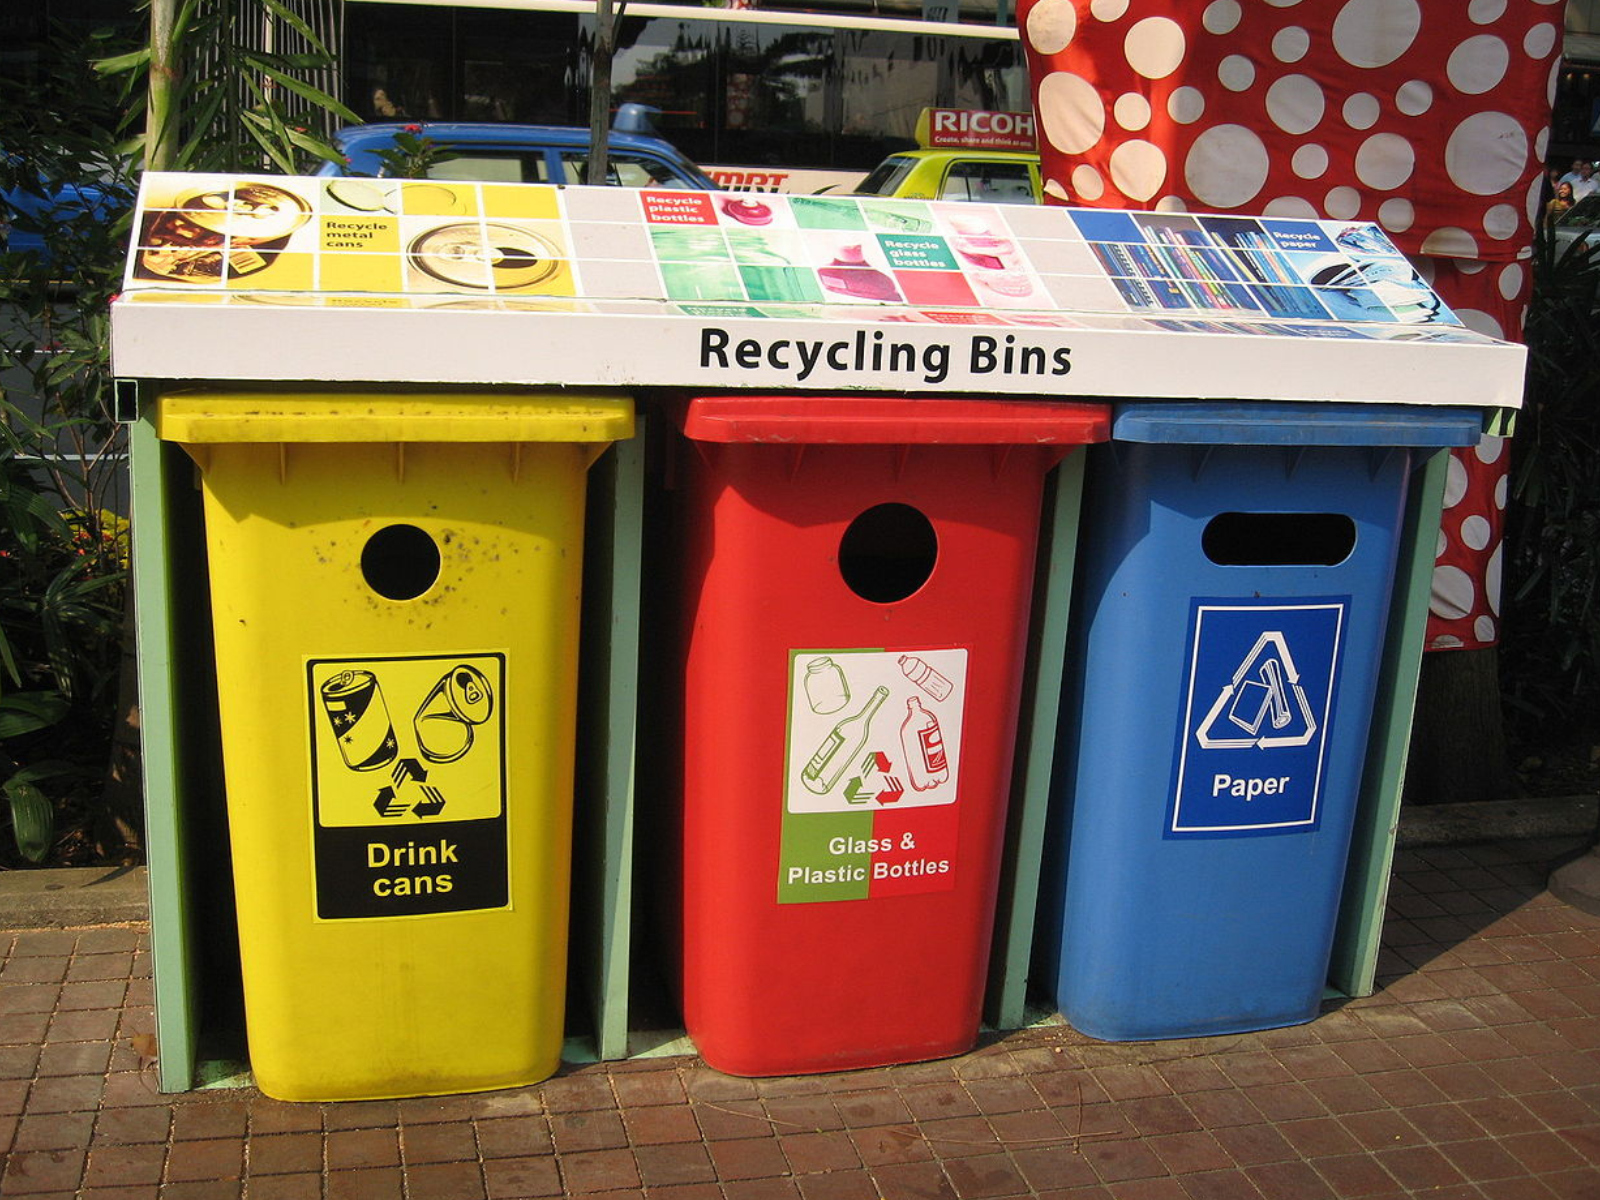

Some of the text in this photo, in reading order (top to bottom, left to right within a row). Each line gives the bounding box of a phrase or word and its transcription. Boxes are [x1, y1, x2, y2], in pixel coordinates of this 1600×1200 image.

[934, 111, 1034, 136] RICOH
[981, 136, 994, 145] and
[704, 171, 789, 194] MRT
[646, 196, 702, 206] Recycle
[648, 204, 698, 213] plastic
[651, 213, 705, 223] bottles
[326, 221, 388, 231] Recycle
[326, 231, 373, 239] metal
[1272, 230, 1321, 241] Recycle
[326, 240, 363, 248] cans
[884, 240, 939, 250] Recycle
[1279, 240, 1317, 249] paper
[889, 249, 927, 259] glass
[893, 258, 947, 268] bottles
[700, 328, 1072, 384] Recycling Bins
[1212, 774, 1290, 801] Paper
[829, 832, 916, 855] Glass &
[367, 839, 458, 868] Drink
[788, 859, 950, 884] Plastic Bottles
[373, 874, 453, 897] cans
